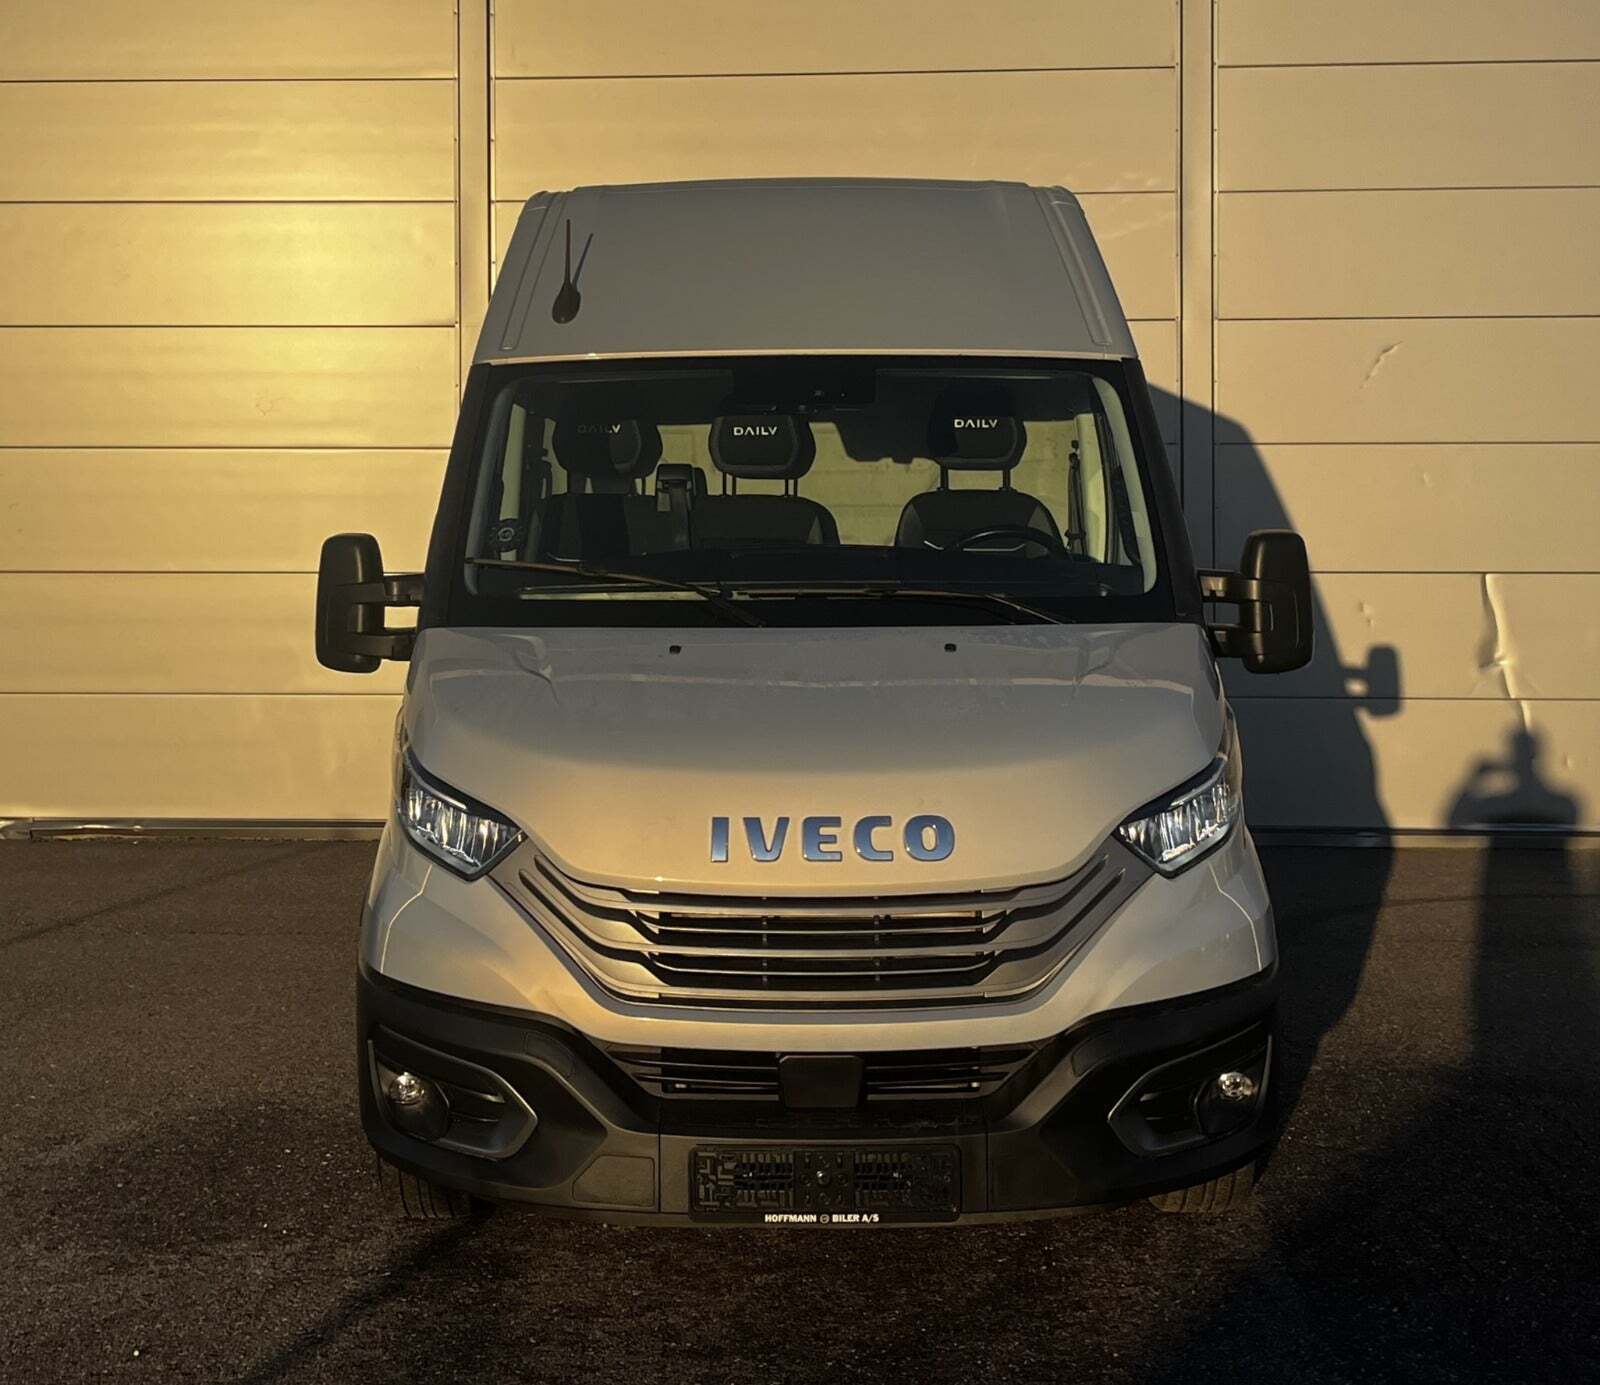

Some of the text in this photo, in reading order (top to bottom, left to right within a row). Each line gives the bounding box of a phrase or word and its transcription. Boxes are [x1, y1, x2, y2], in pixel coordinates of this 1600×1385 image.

[710, 815, 955, 862] IVECO
[764, 1213, 880, 1223] HOFFMANN BILER A/S
